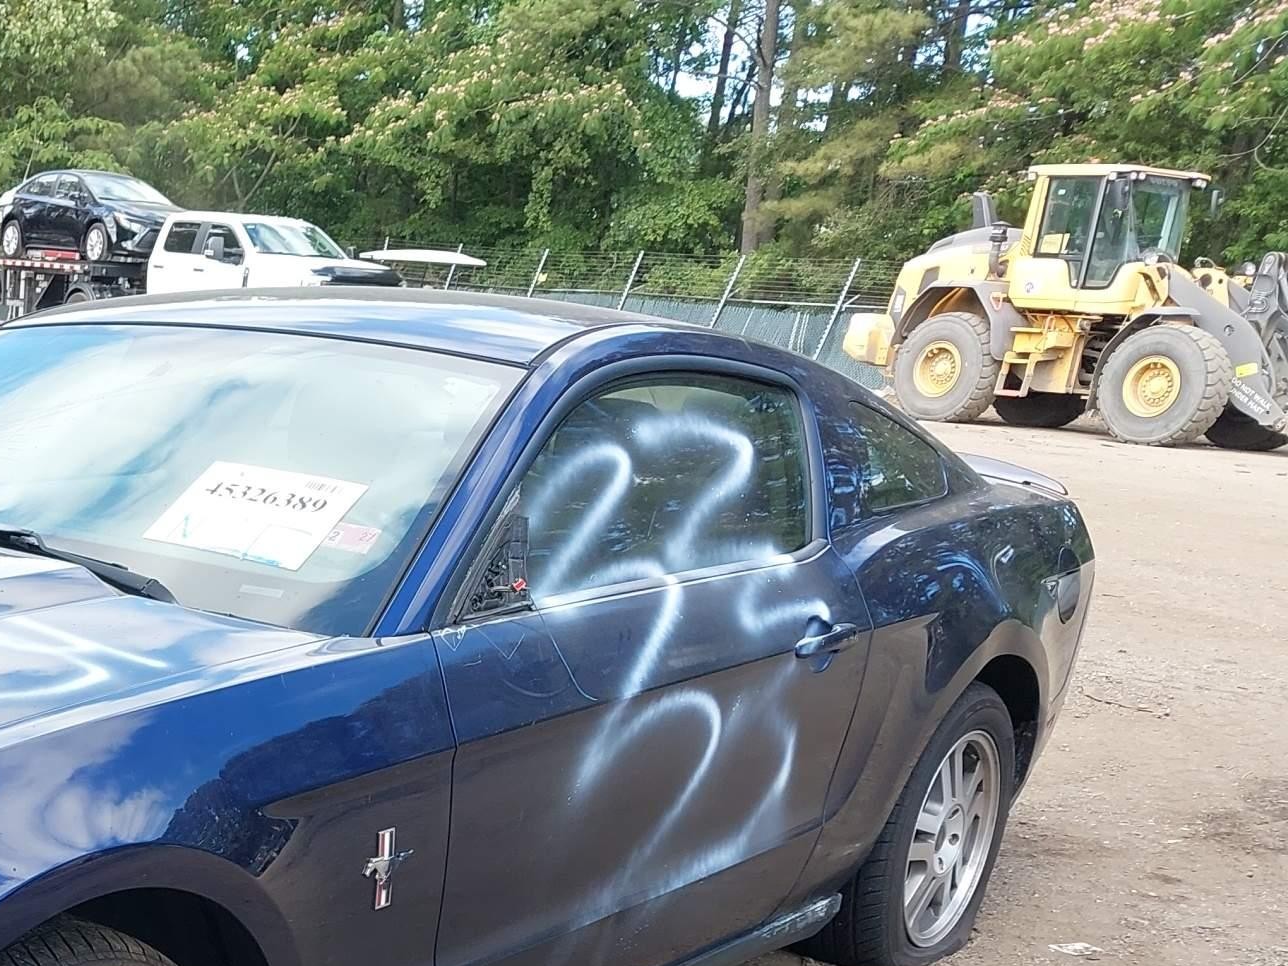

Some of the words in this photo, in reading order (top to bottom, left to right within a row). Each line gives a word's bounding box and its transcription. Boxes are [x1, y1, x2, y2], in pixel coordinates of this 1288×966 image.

[1241, 383, 1256, 396] NOT
[1253, 393, 1272, 410] WALK
[205, 482, 328, 513] 45326389
